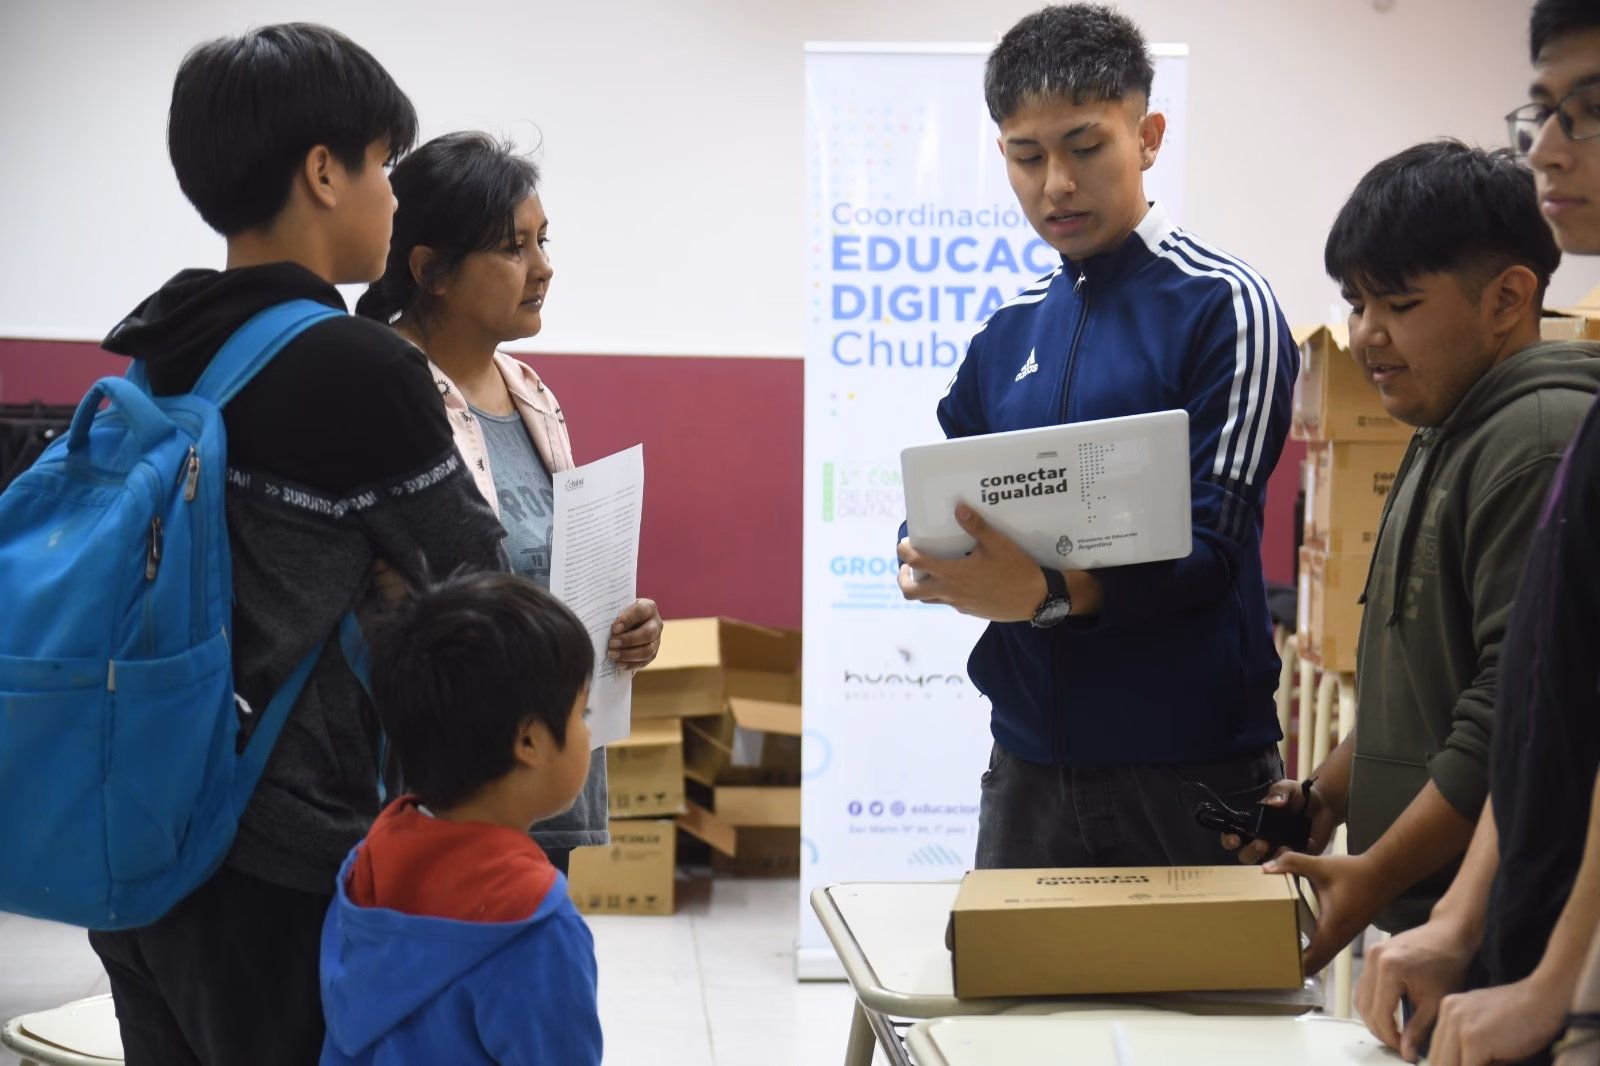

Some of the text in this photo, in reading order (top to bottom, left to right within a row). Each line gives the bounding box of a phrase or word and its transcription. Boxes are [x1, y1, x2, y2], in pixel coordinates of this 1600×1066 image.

[831, 284, 1028, 322] DIGITA
[831, 329, 969, 367] Chub
[980, 467, 1067, 488] conectar
[981, 479, 1068, 505] igualdad
[1078, 541, 1112, 551] Argentina
